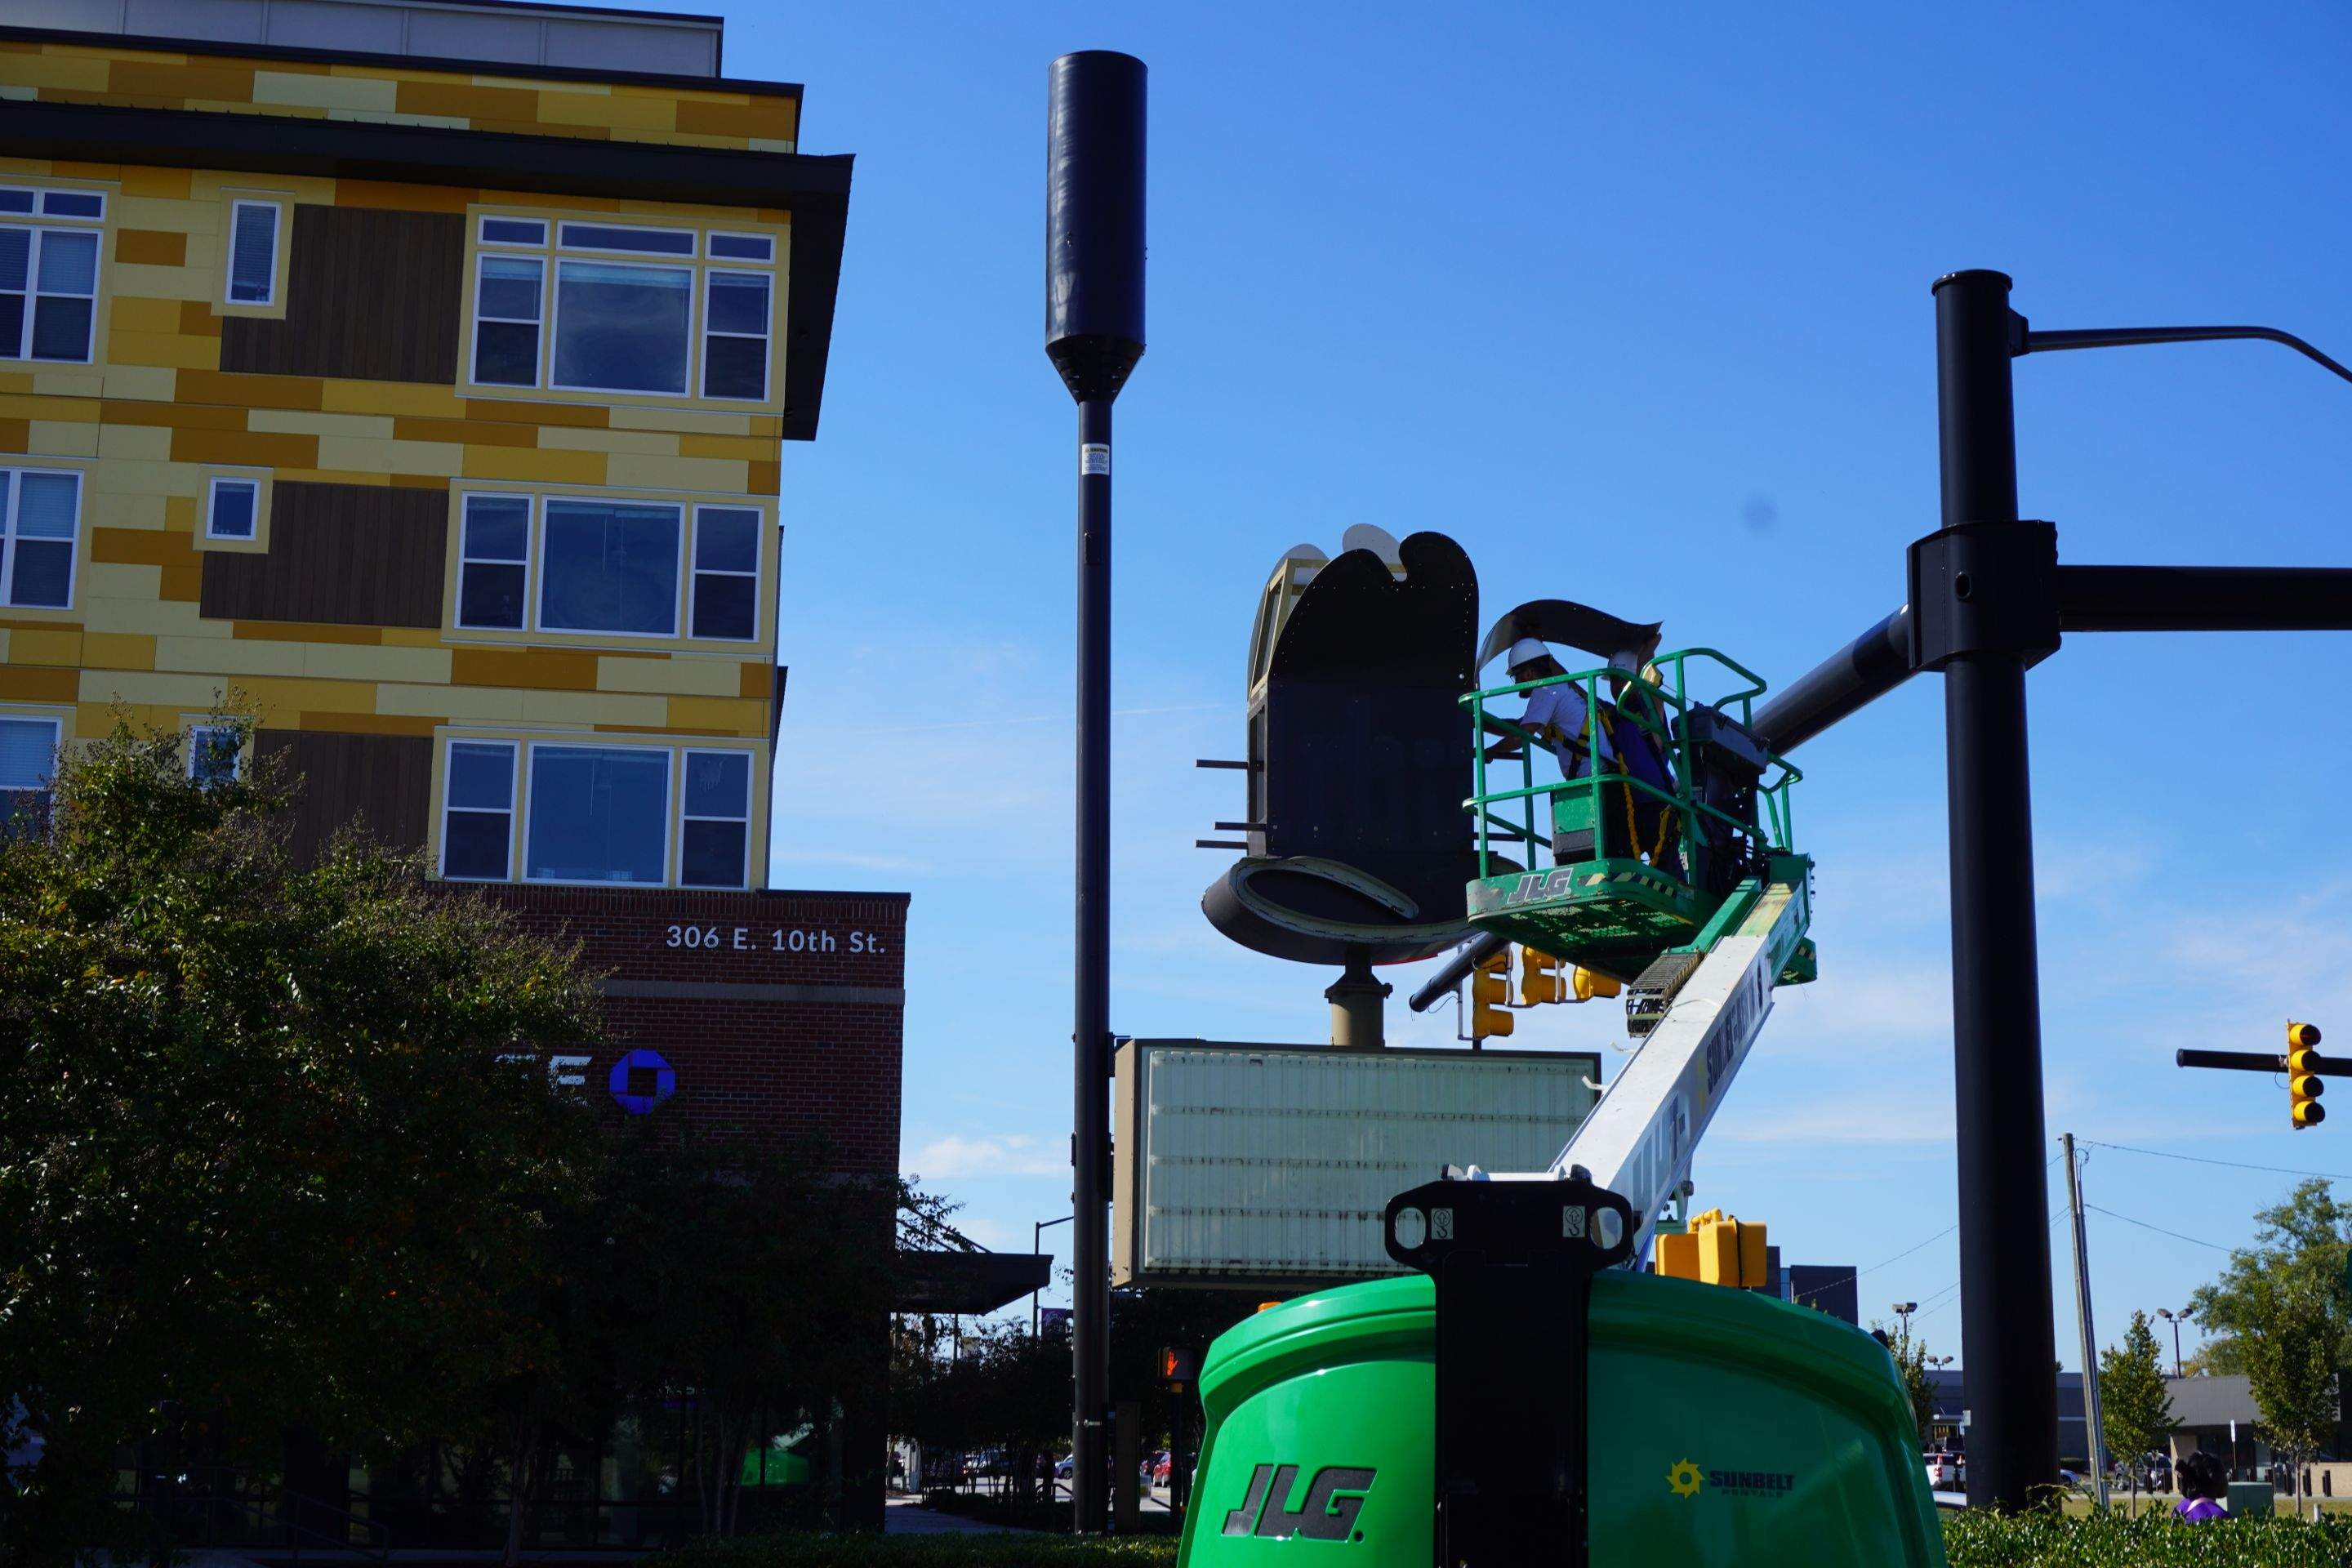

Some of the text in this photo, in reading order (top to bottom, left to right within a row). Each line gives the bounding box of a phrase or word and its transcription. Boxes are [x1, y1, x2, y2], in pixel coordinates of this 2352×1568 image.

[666, 925, 886, 953] 306 E. 10th St.
[1709, 1470, 1794, 1490] SUNBELT
